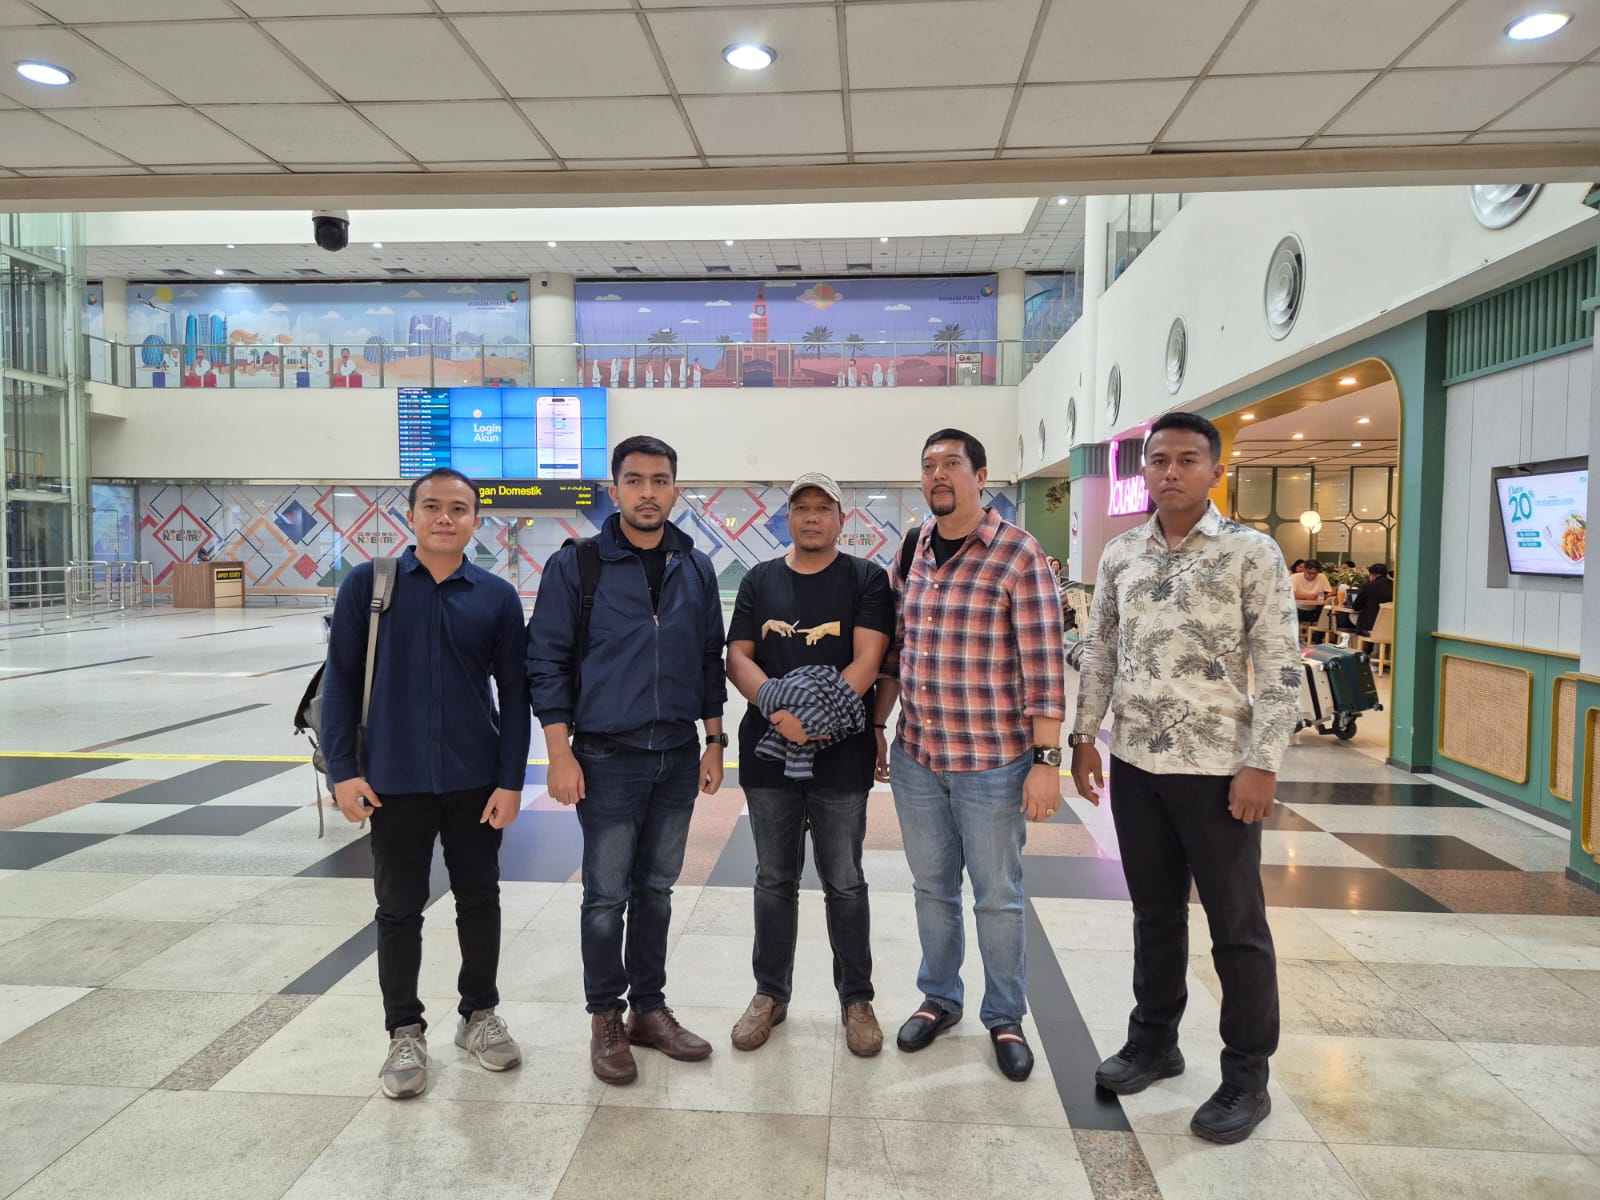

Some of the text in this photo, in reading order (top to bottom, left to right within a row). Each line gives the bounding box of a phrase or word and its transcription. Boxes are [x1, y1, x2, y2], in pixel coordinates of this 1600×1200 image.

[473, 424, 502, 434] Login
[473, 433, 499, 442] Akun
[498, 485, 542, 496] Domestik
[371, 536, 398, 544] ENTRY
[848, 538, 875, 546] ENTRY
